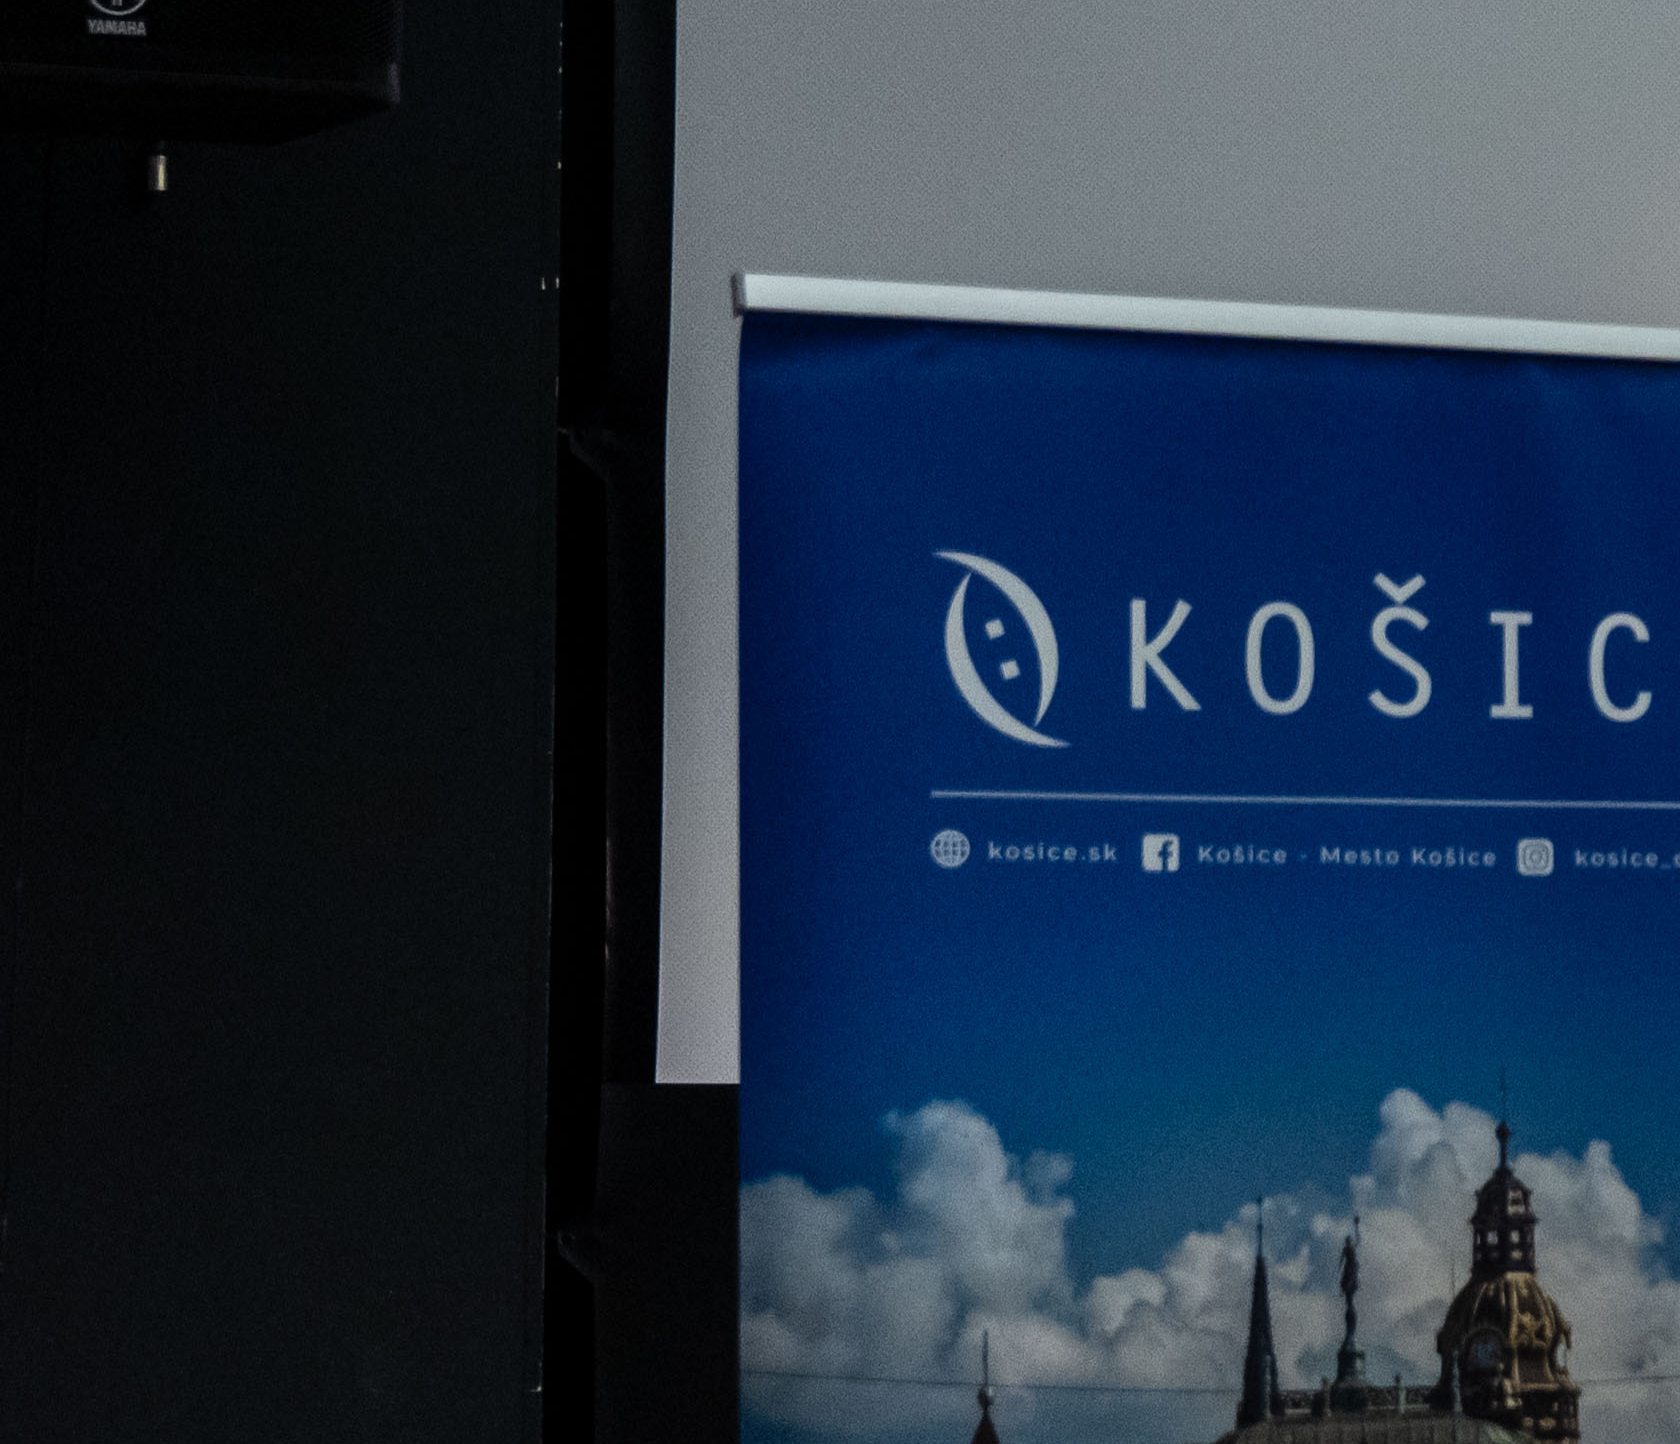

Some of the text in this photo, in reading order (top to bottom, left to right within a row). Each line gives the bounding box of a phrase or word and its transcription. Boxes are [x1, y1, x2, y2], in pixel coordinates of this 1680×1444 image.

[87, 18, 147, 36] YAMAHA
[987, 839, 1118, 864] kosice.sk
[1197, 841, 1289, 865] Košice
[1319, 843, 1401, 866] Mesto
[1410, 842, 1498, 868] Košice
